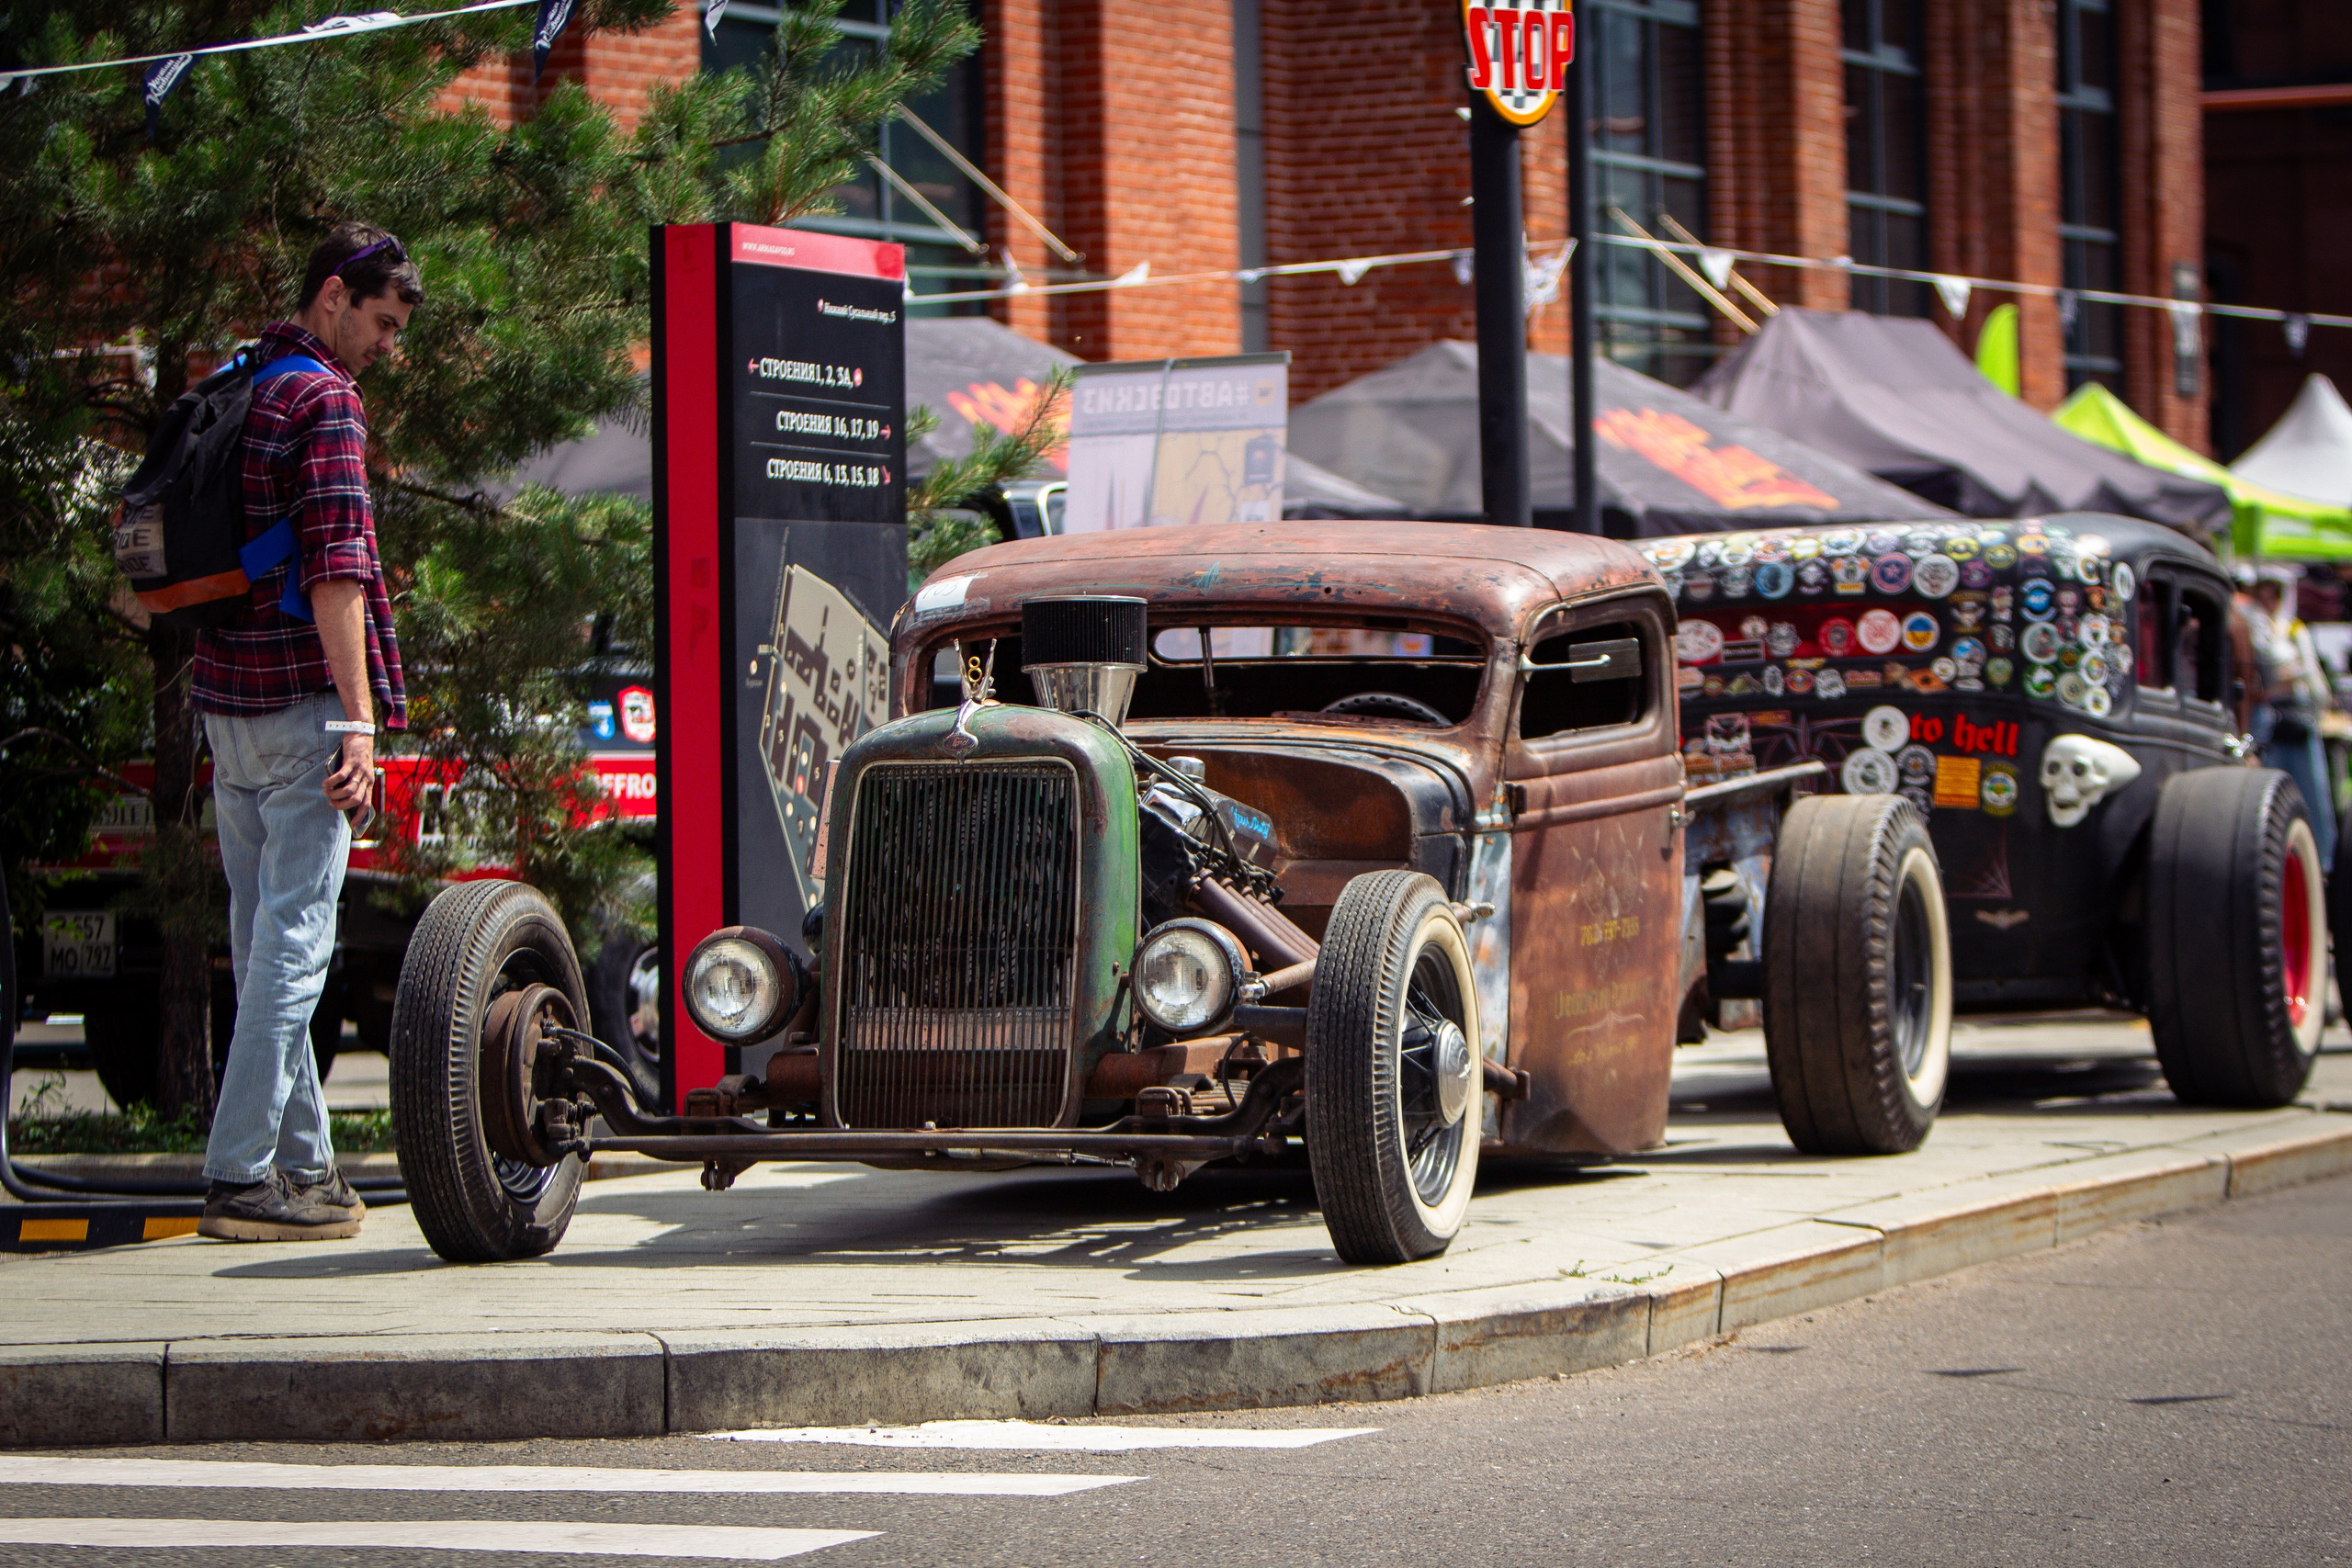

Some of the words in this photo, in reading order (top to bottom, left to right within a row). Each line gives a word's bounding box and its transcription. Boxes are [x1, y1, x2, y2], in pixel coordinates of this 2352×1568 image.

[1467, 7, 1575, 91] STOP
[759, 357, 816, 382] СТРОЕНИЯ
[825, 366, 836, 388] 2,
[776, 411, 832, 434] СТРОЕНИЯ
[833, 416, 849, 439] 16,
[850, 418, 865, 441] 17,
[866, 420, 879, 439] 19
[766, 457, 822, 483] СТРОЕНИЯ
[822, 463, 833, 486] 6,
[834, 465, 850, 487] 13,
[850, 466, 865, 489] 15,
[866, 467, 879, 488] 18
[1910, 712, 1943, 743] to
[1953, 713, 2019, 757] hell
